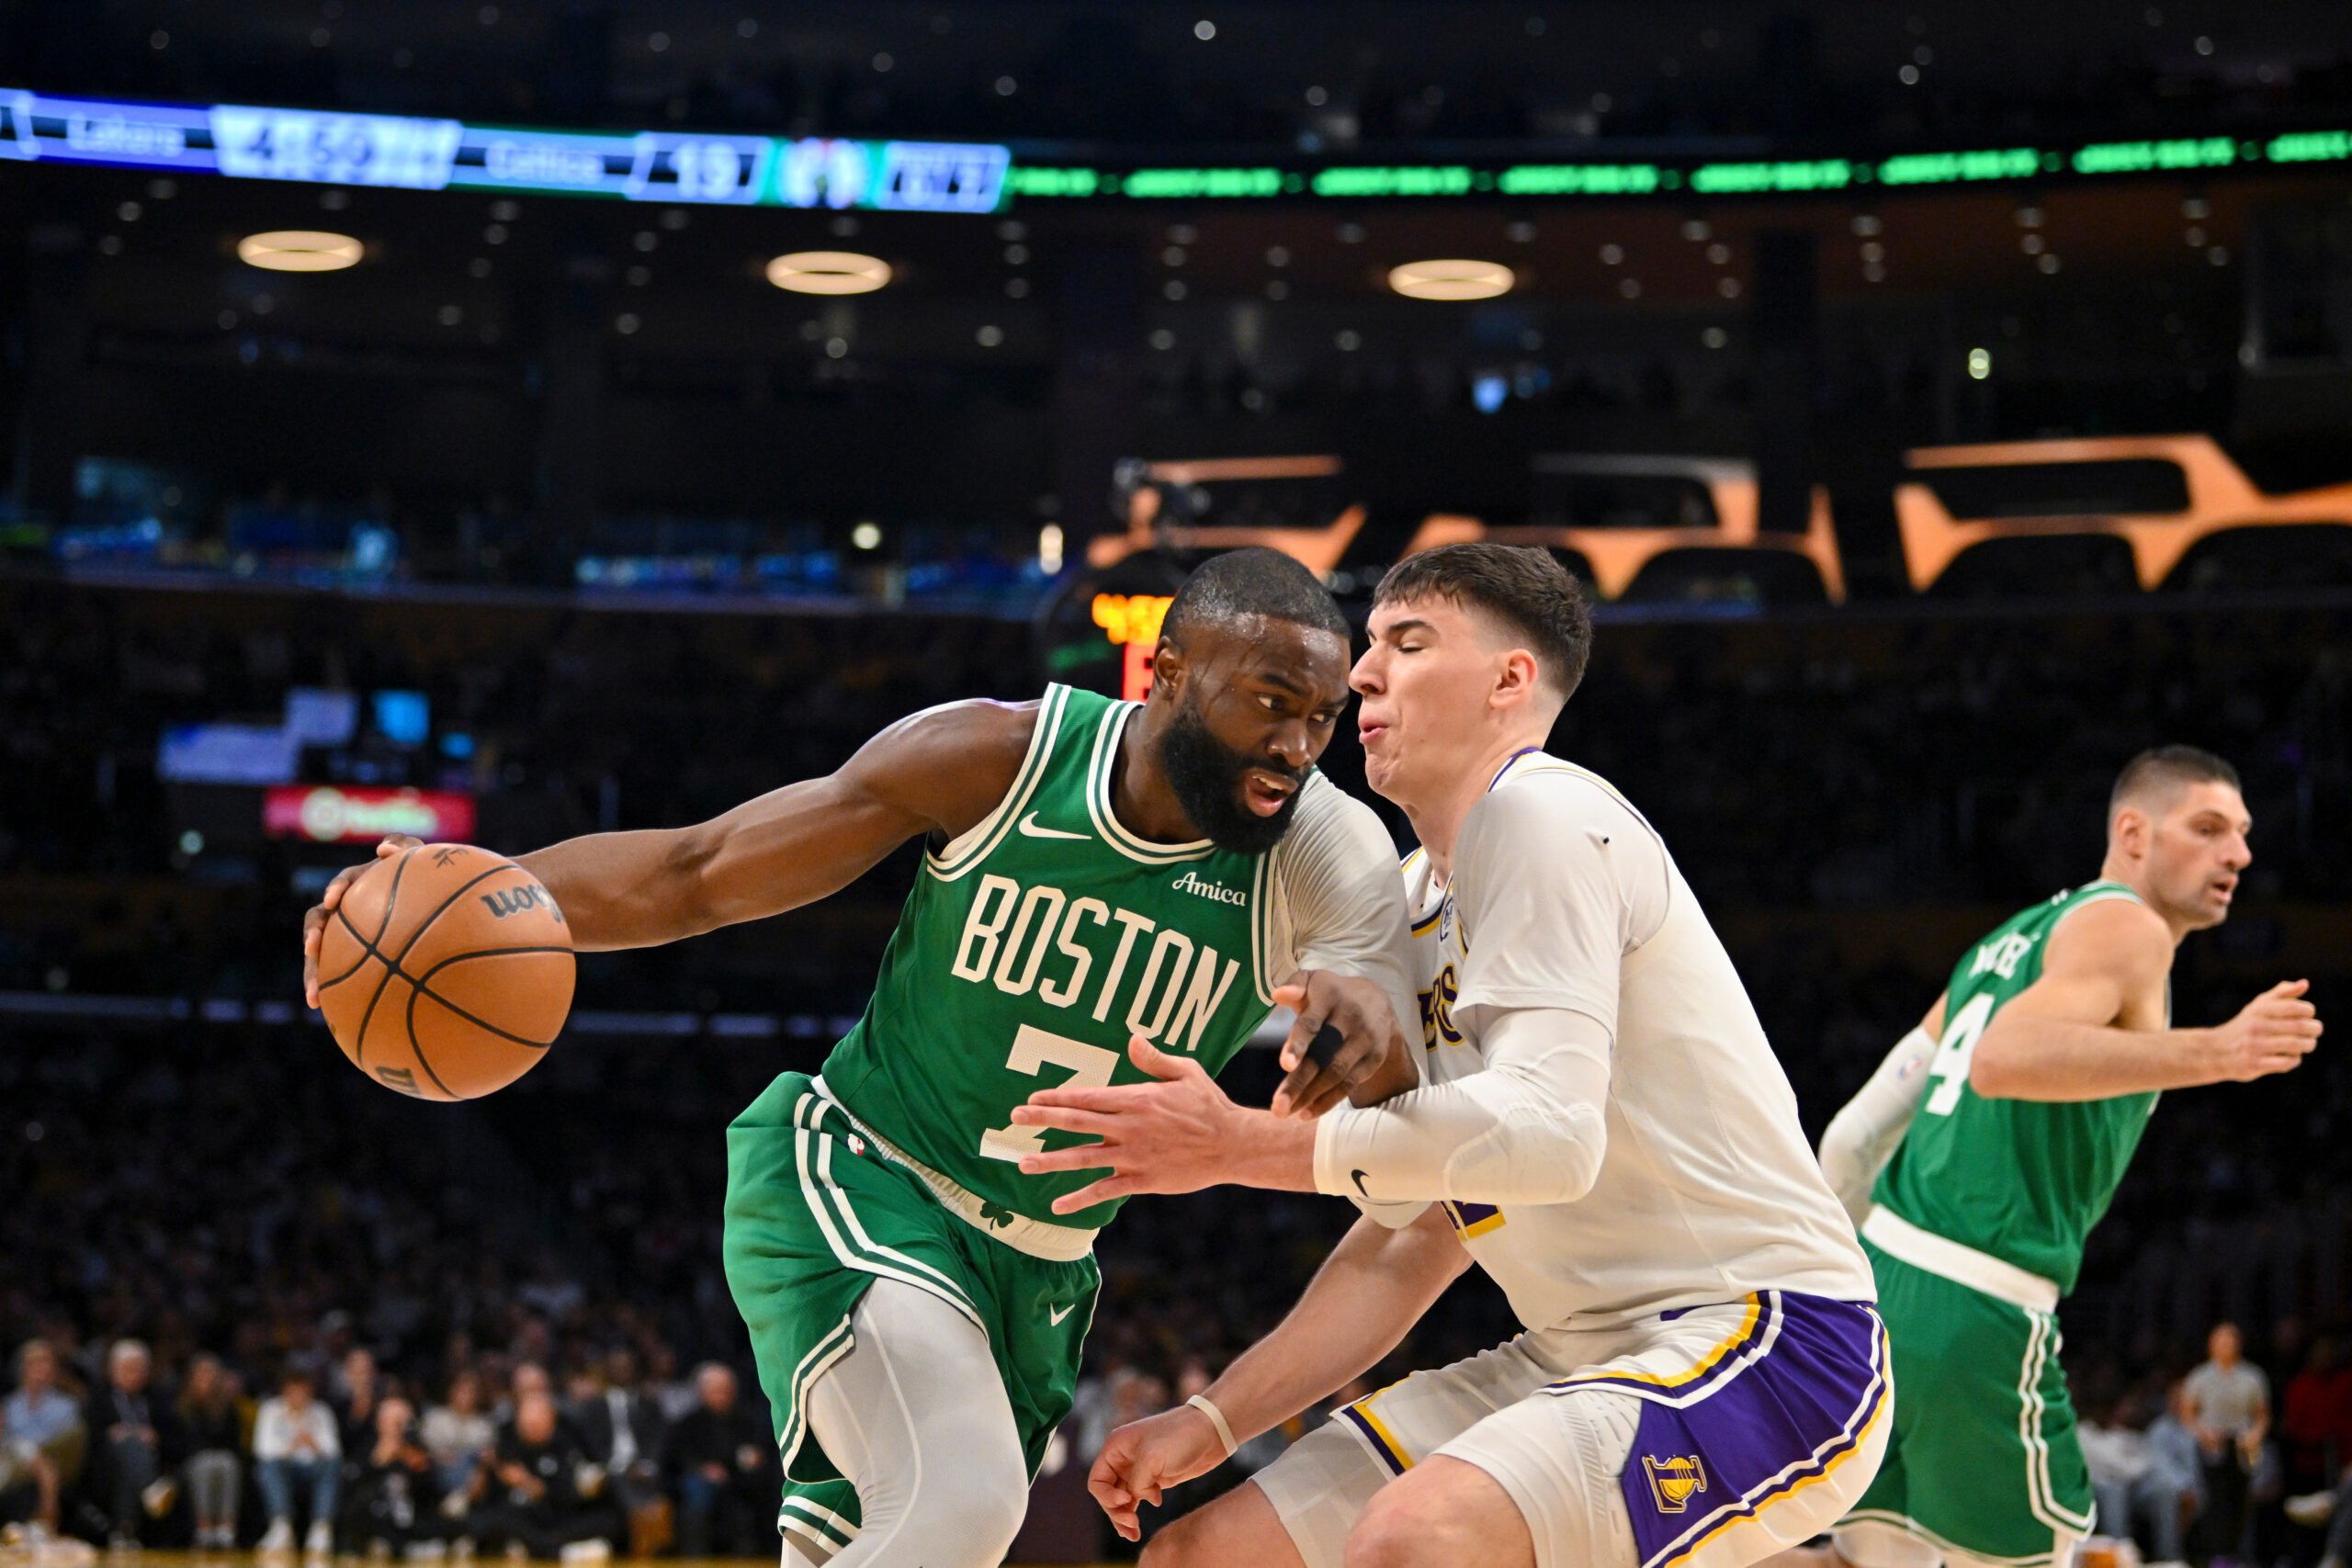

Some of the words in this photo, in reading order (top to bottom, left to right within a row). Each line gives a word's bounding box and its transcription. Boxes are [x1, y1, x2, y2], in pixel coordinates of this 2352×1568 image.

[1171, 872, 1247, 908] Amica
[951, 874, 1240, 1052] BOSTON
[979, 1023, 1120, 1164] 7
[1925, 992, 1995, 1116] 4
